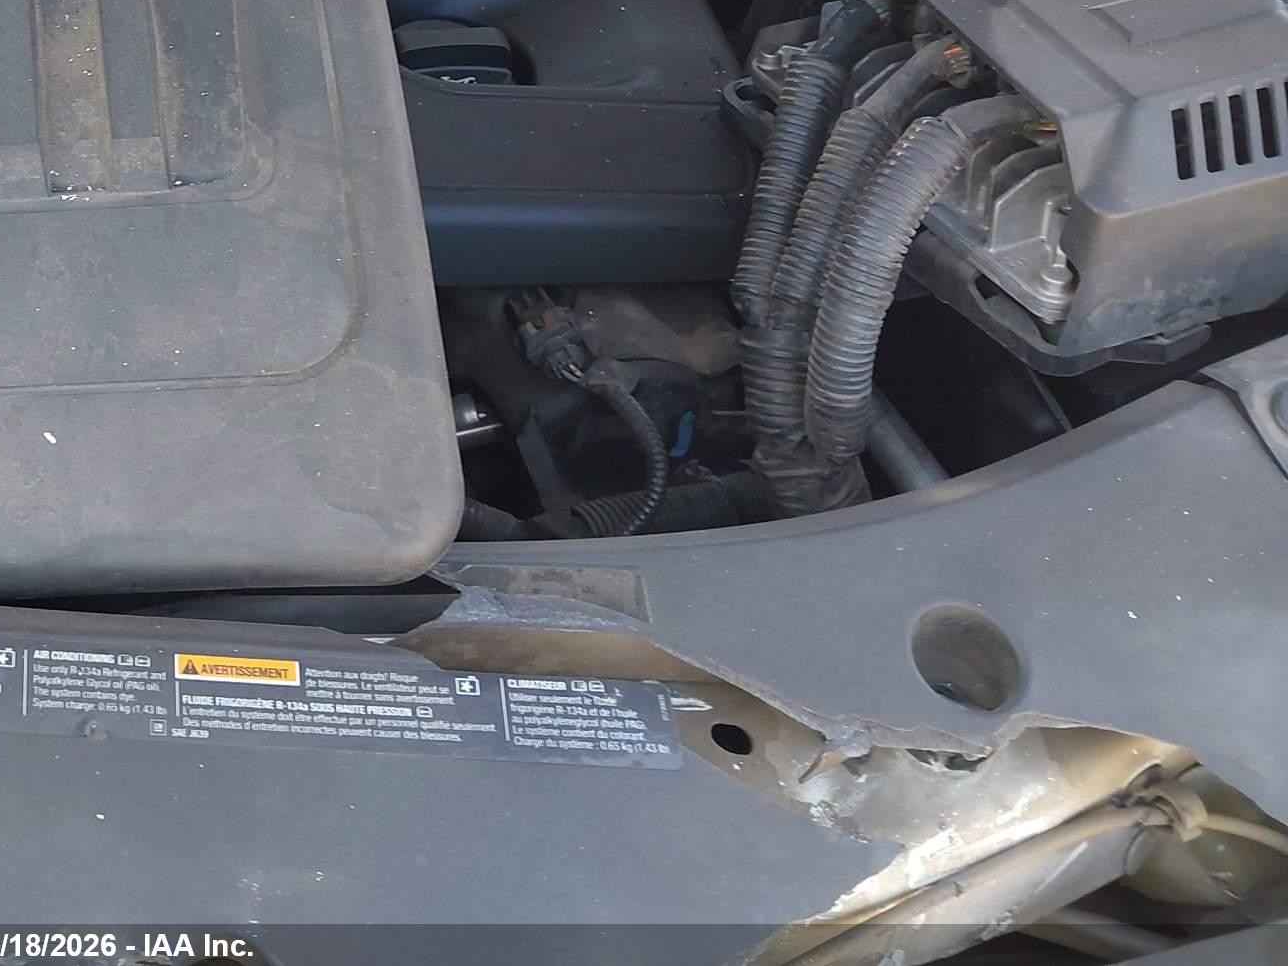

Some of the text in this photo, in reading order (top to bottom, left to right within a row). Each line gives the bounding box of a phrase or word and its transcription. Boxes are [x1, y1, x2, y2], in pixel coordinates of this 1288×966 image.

[33, 650, 115, 664] AIR CONDITIONING
[33, 663, 49, 673] Use
[51, 664, 68, 676] only
[102, 667, 149, 680] Refrigerant
[150, 672, 167, 680] and
[201, 664, 289, 679] AVERTISSEMENT
[305, 668, 342, 678] Attention
[343, 671, 359, 679] aux
[33, 674, 85, 687] Polyalkylene
[85, 678, 112, 689] Glycol
[112, 679, 124, 689] oil
[125, 680, 145, 690] (PAG
[305, 679, 317, 688] de
[360, 681, 372, 691] Le
[373, 683, 417, 693] ventilateur
[418, 686, 438, 695] peut
[507, 679, 566, 691] CLIMATISEUR
[33, 686, 50, 696] The
[51, 689, 81, 698] system
[82, 691, 118, 700] contains
[306, 689, 334, 698] mettre
[342, 691, 372, 700] tourner
[374, 693, 394, 702] sans
[395, 694, 456, 705] avertissement.
[508, 692, 538, 702] Utiliser
[538, 695, 582, 705] seulement
[32, 697, 65, 709] System
[119, 704, 132, 715] kg
[182, 694, 215, 706] FLUIDE
[275, 700, 309, 711] R-134a
[309, 702, 335, 713] SOUS
[335, 704, 366, 714] HAUTE
[366, 705, 412, 717] PRESSION
[588, 708, 599, 716] et
[598, 708, 611, 717] de
[228, 708, 240, 718] du
[348, 717, 363, 726] par
[377, 719, 419, 728] personnel
[452, 722, 497, 732] seulement.
[511, 715, 524, 724] au
[182, 717, 200, 727] Des
[402, 730, 420, 739] des
[512, 725, 524, 735] Le
[561, 729, 596, 738] contient
[596, 730, 609, 739] du
[513, 736, 545, 748] Charge
[545, 738, 558, 747] du
[620, 742, 633, 753] kg
